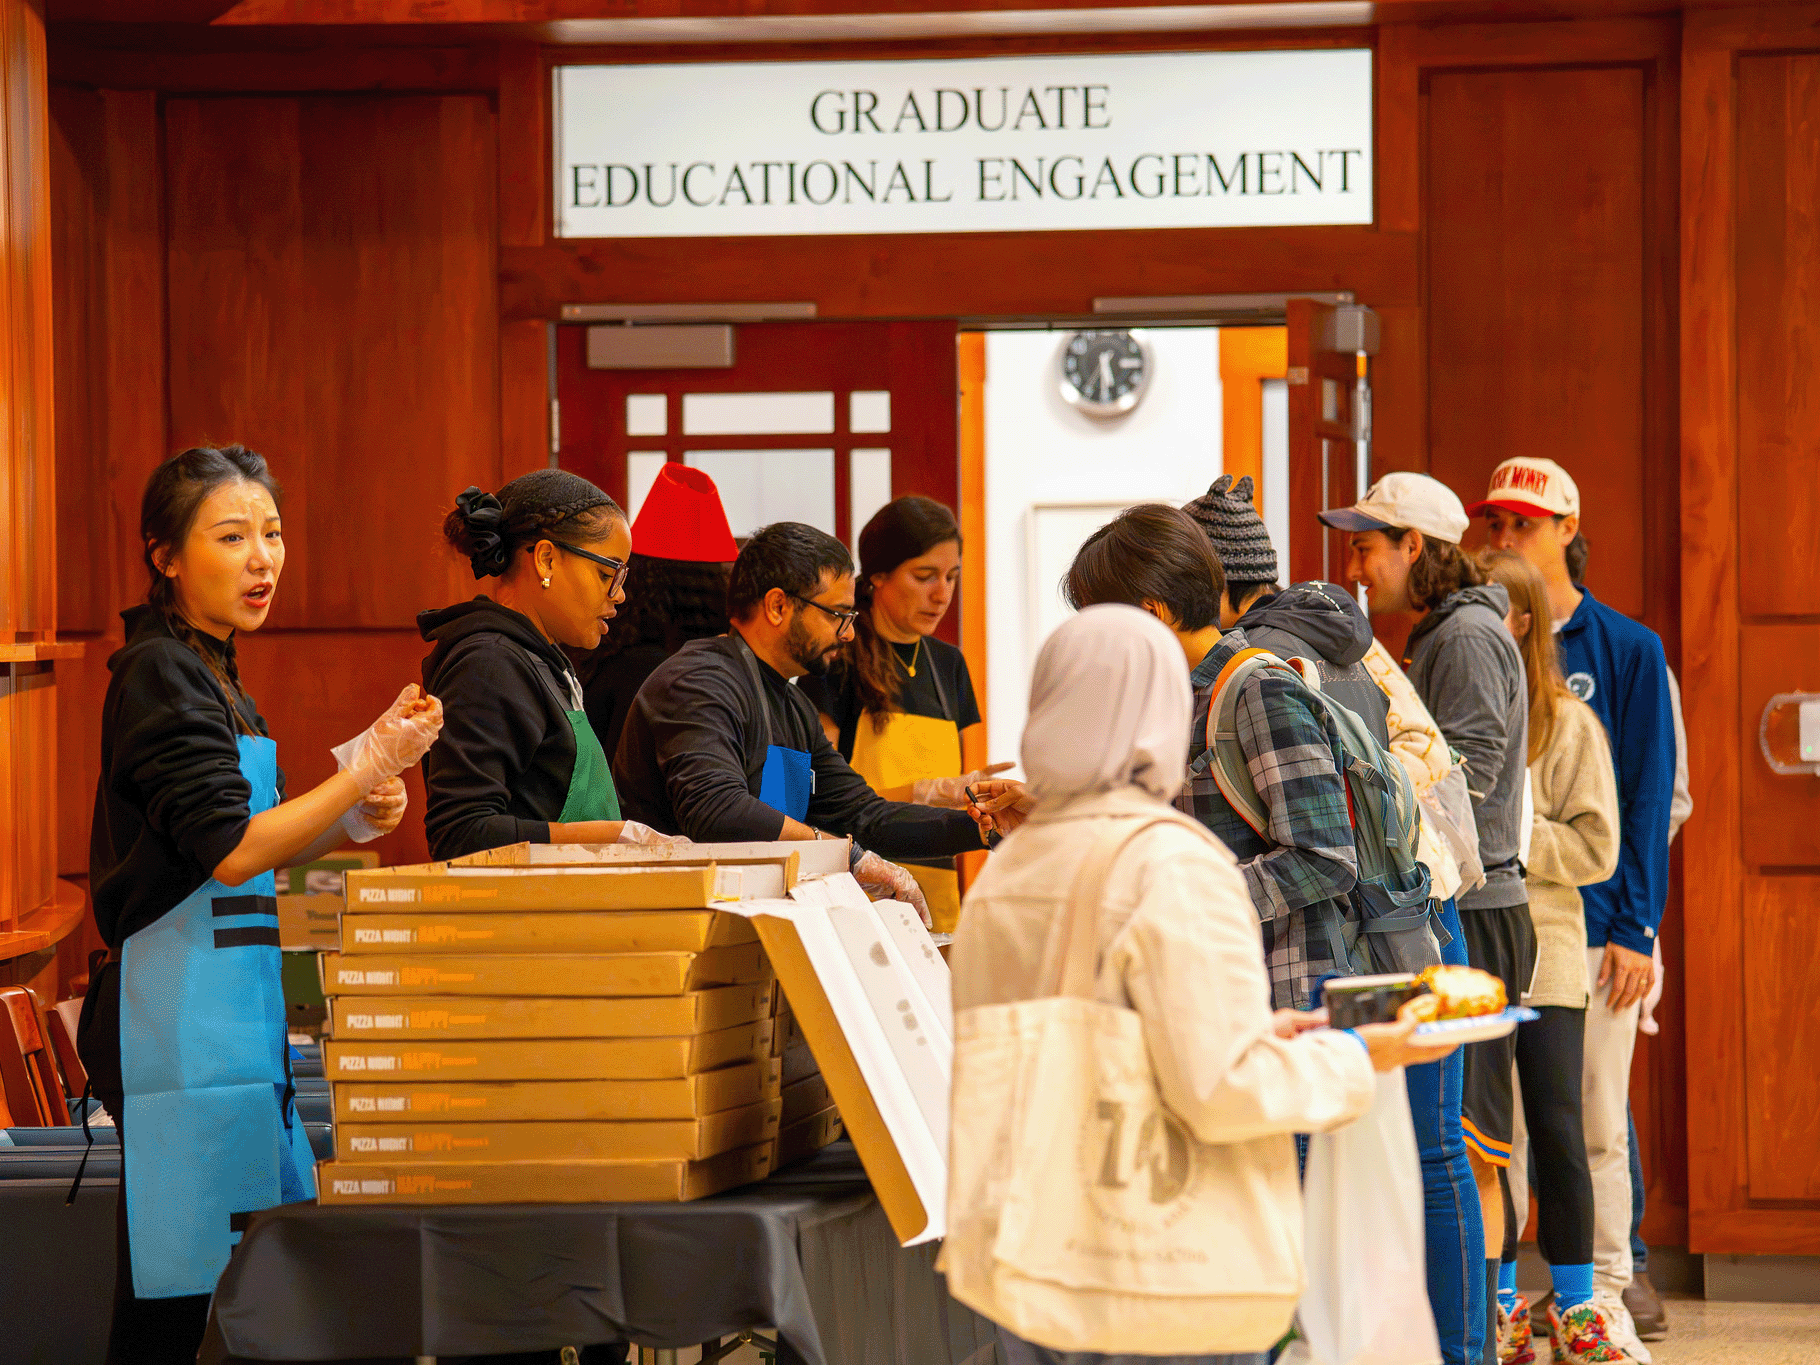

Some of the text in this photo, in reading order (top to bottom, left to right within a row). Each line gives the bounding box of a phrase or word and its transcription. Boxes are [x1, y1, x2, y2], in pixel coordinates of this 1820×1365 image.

[810, 84, 1112, 134] GRADUATE
[570, 148, 1363, 209] EDUCATIONAL ENGAGEMENT
[359, 888, 387, 902] PIZZA
[354, 928, 382, 943] PIZZA
[338, 970, 365, 985] PIZZA
[346, 1014, 374, 1030] PIZZA
[339, 1055, 366, 1070] PIZZA
[350, 1097, 376, 1112] PIZZA
[350, 1136, 378, 1152] PIZZA
[333, 1179, 361, 1195] PIZZA
